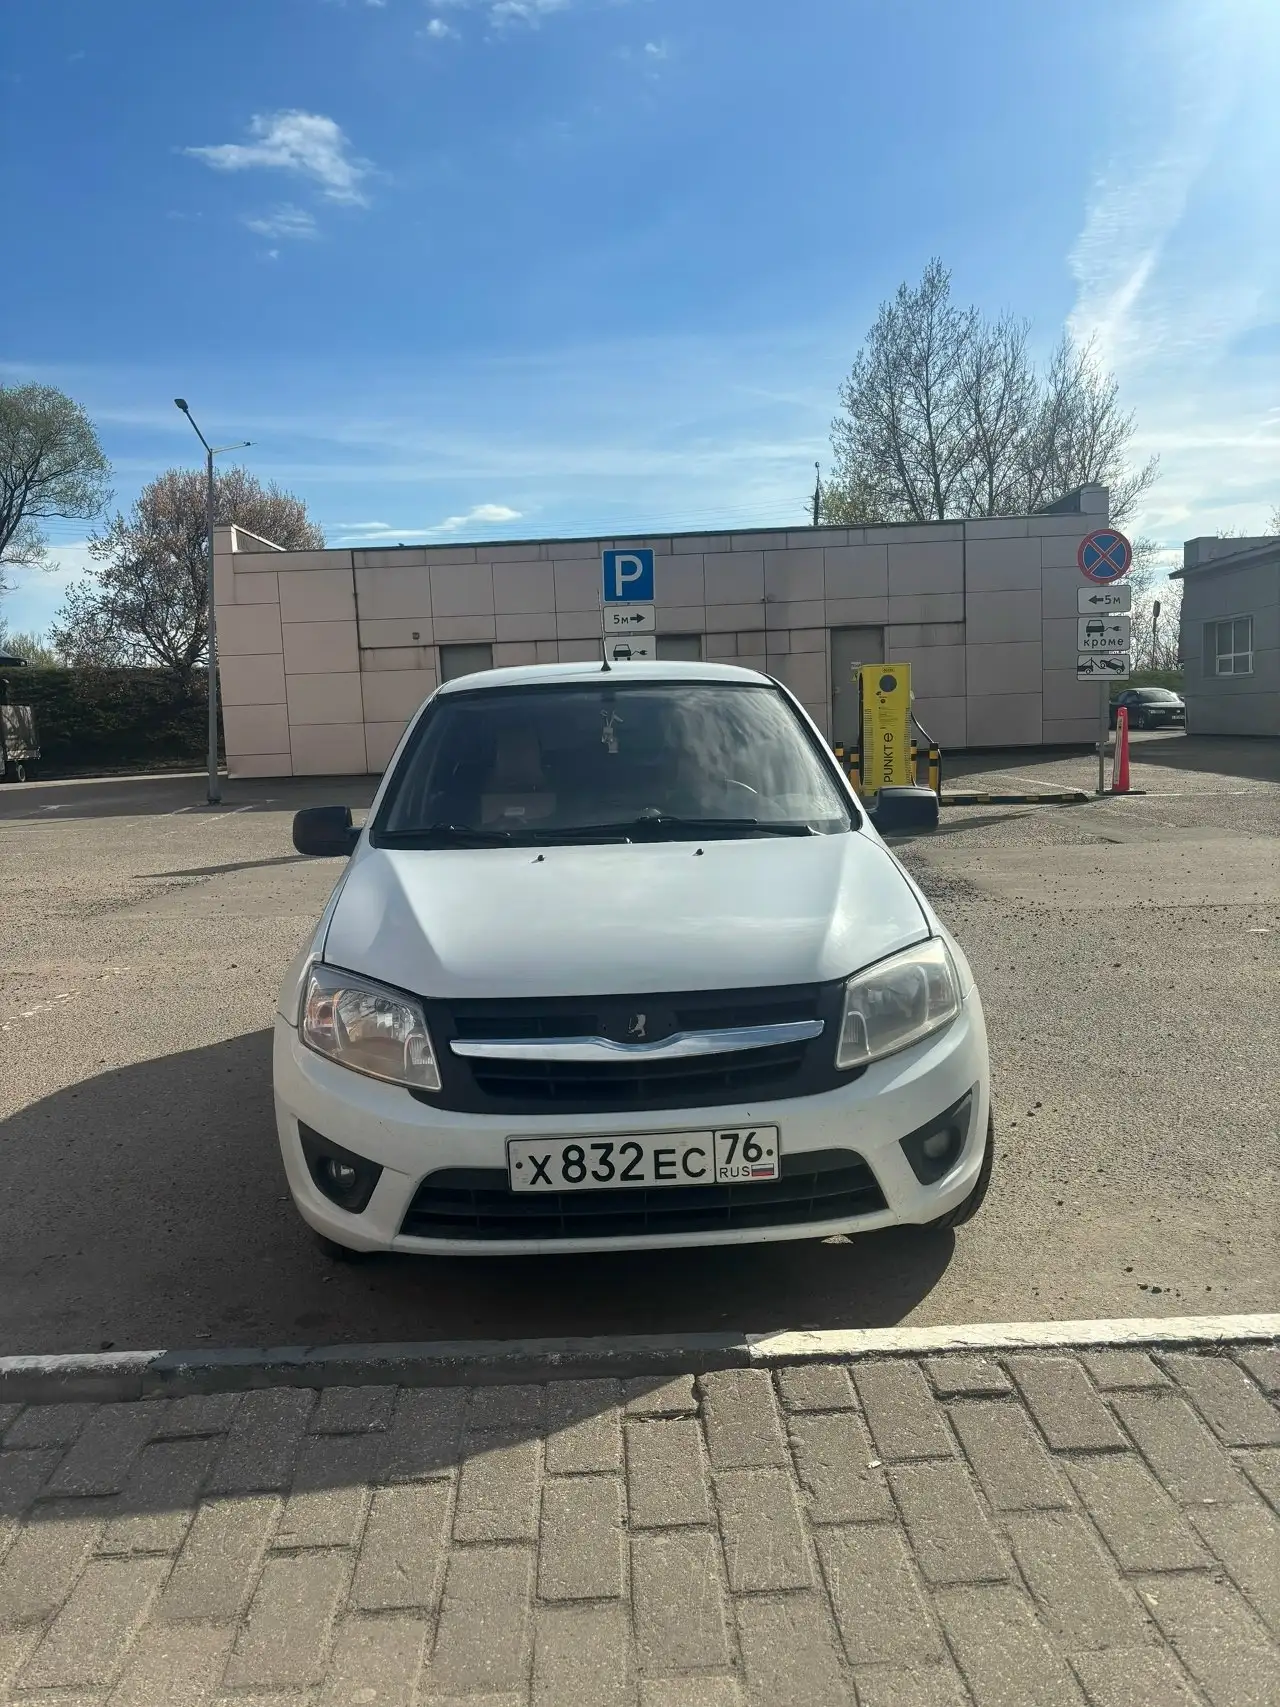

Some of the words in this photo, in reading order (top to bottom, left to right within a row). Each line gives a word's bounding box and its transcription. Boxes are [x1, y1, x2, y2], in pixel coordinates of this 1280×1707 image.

[615, 554, 643, 597] P
[1083, 637, 1124, 649] кроме
[720, 1131, 763, 1165] 76
[719, 1166, 750, 1179] RUS
